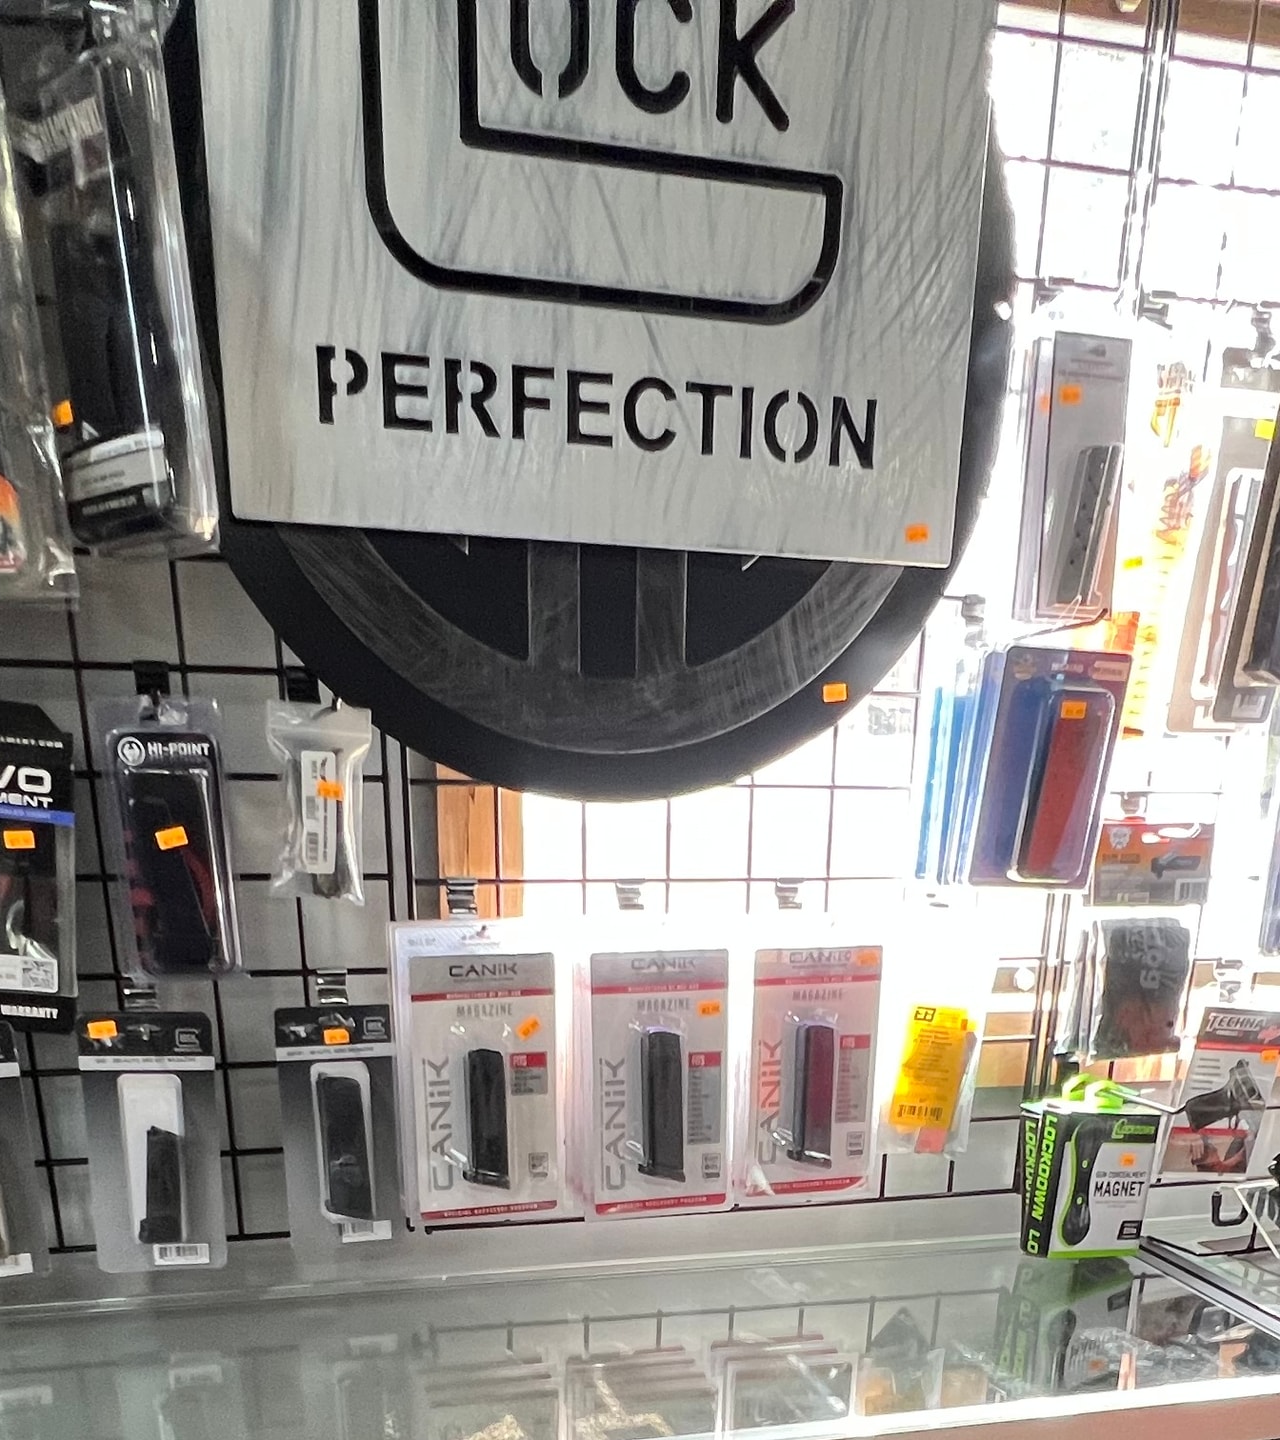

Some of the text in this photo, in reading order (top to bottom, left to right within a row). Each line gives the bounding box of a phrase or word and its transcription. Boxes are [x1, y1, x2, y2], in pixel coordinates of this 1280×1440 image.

[315, 344, 878, 471] PERFECTION
[147, 741, 211, 757] HI-POINT
[792, 988, 844, 1001] MAGAZINE
[457, 1003, 514, 1017] MAGAZINE
[637, 998, 690, 1012] MAGAZINE
[1032, 1115, 1058, 1222] LOCKDOWN
[1093, 1181, 1146, 1197] MAGNET
